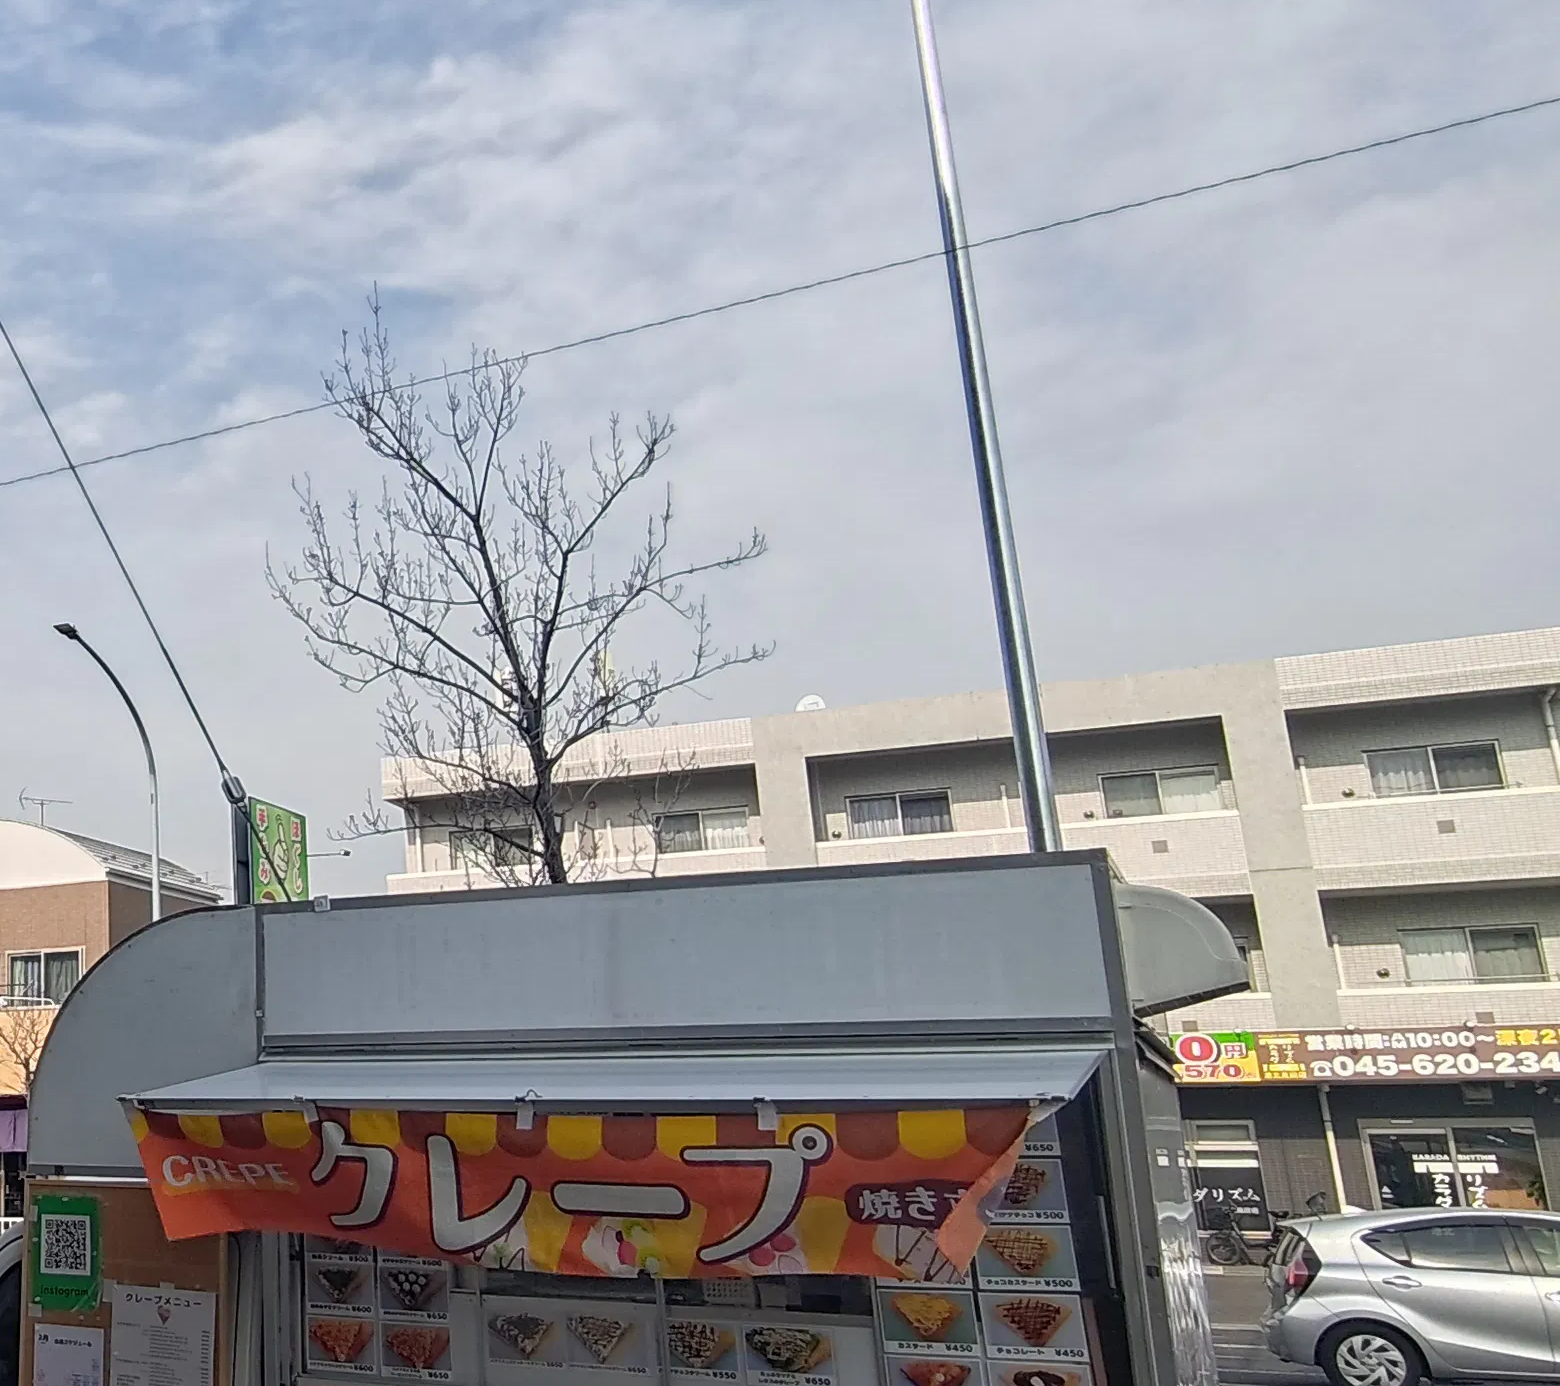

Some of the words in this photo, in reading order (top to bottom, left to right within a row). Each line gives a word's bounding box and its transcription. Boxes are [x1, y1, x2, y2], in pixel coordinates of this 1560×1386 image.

[311, 1121, 833, 1264] クレープ
[125, 1293, 202, 1308] クレープメニュー
